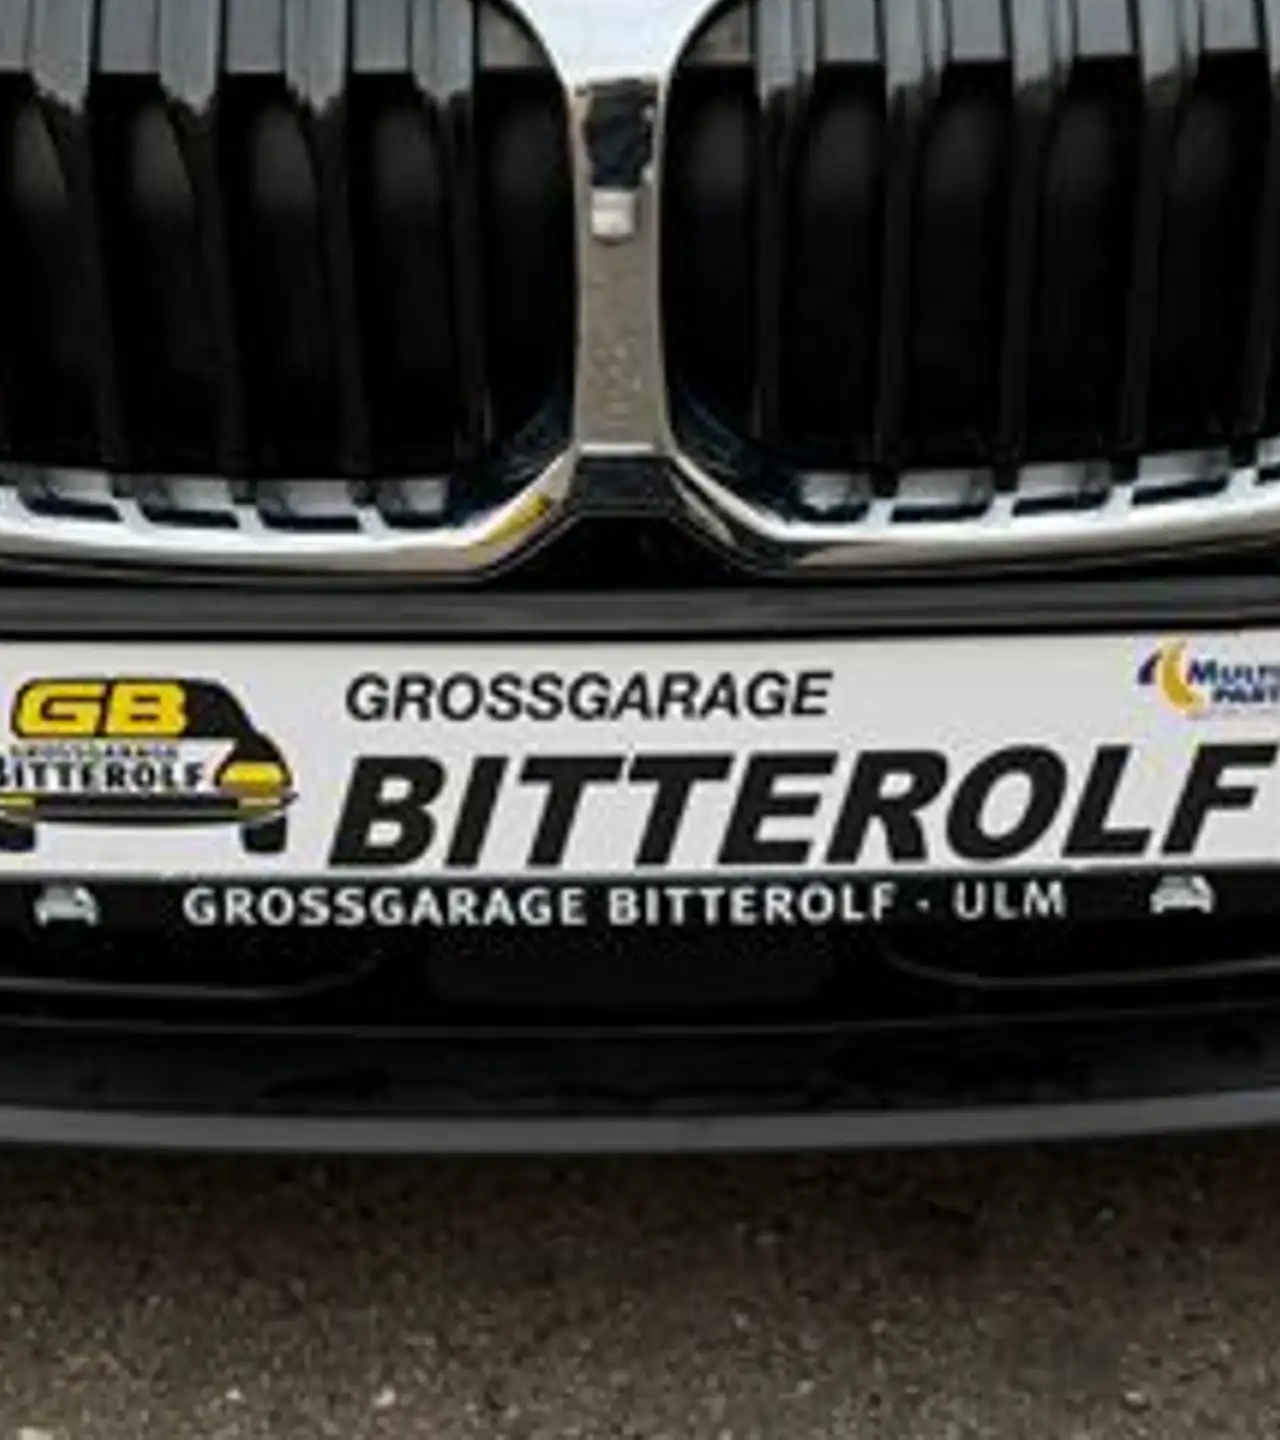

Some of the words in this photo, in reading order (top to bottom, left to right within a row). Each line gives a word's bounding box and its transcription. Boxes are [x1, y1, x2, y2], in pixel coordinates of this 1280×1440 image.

[17, 679, 188, 737] GB
[345, 670, 834, 722] GROSSGARAGE
[329, 743, 1278, 870] BITTEROLF
[183, 886, 586, 927] GROSSGARAGE
[608, 882, 895, 926] BITTEROLF
[952, 878, 1067, 920] ULM
